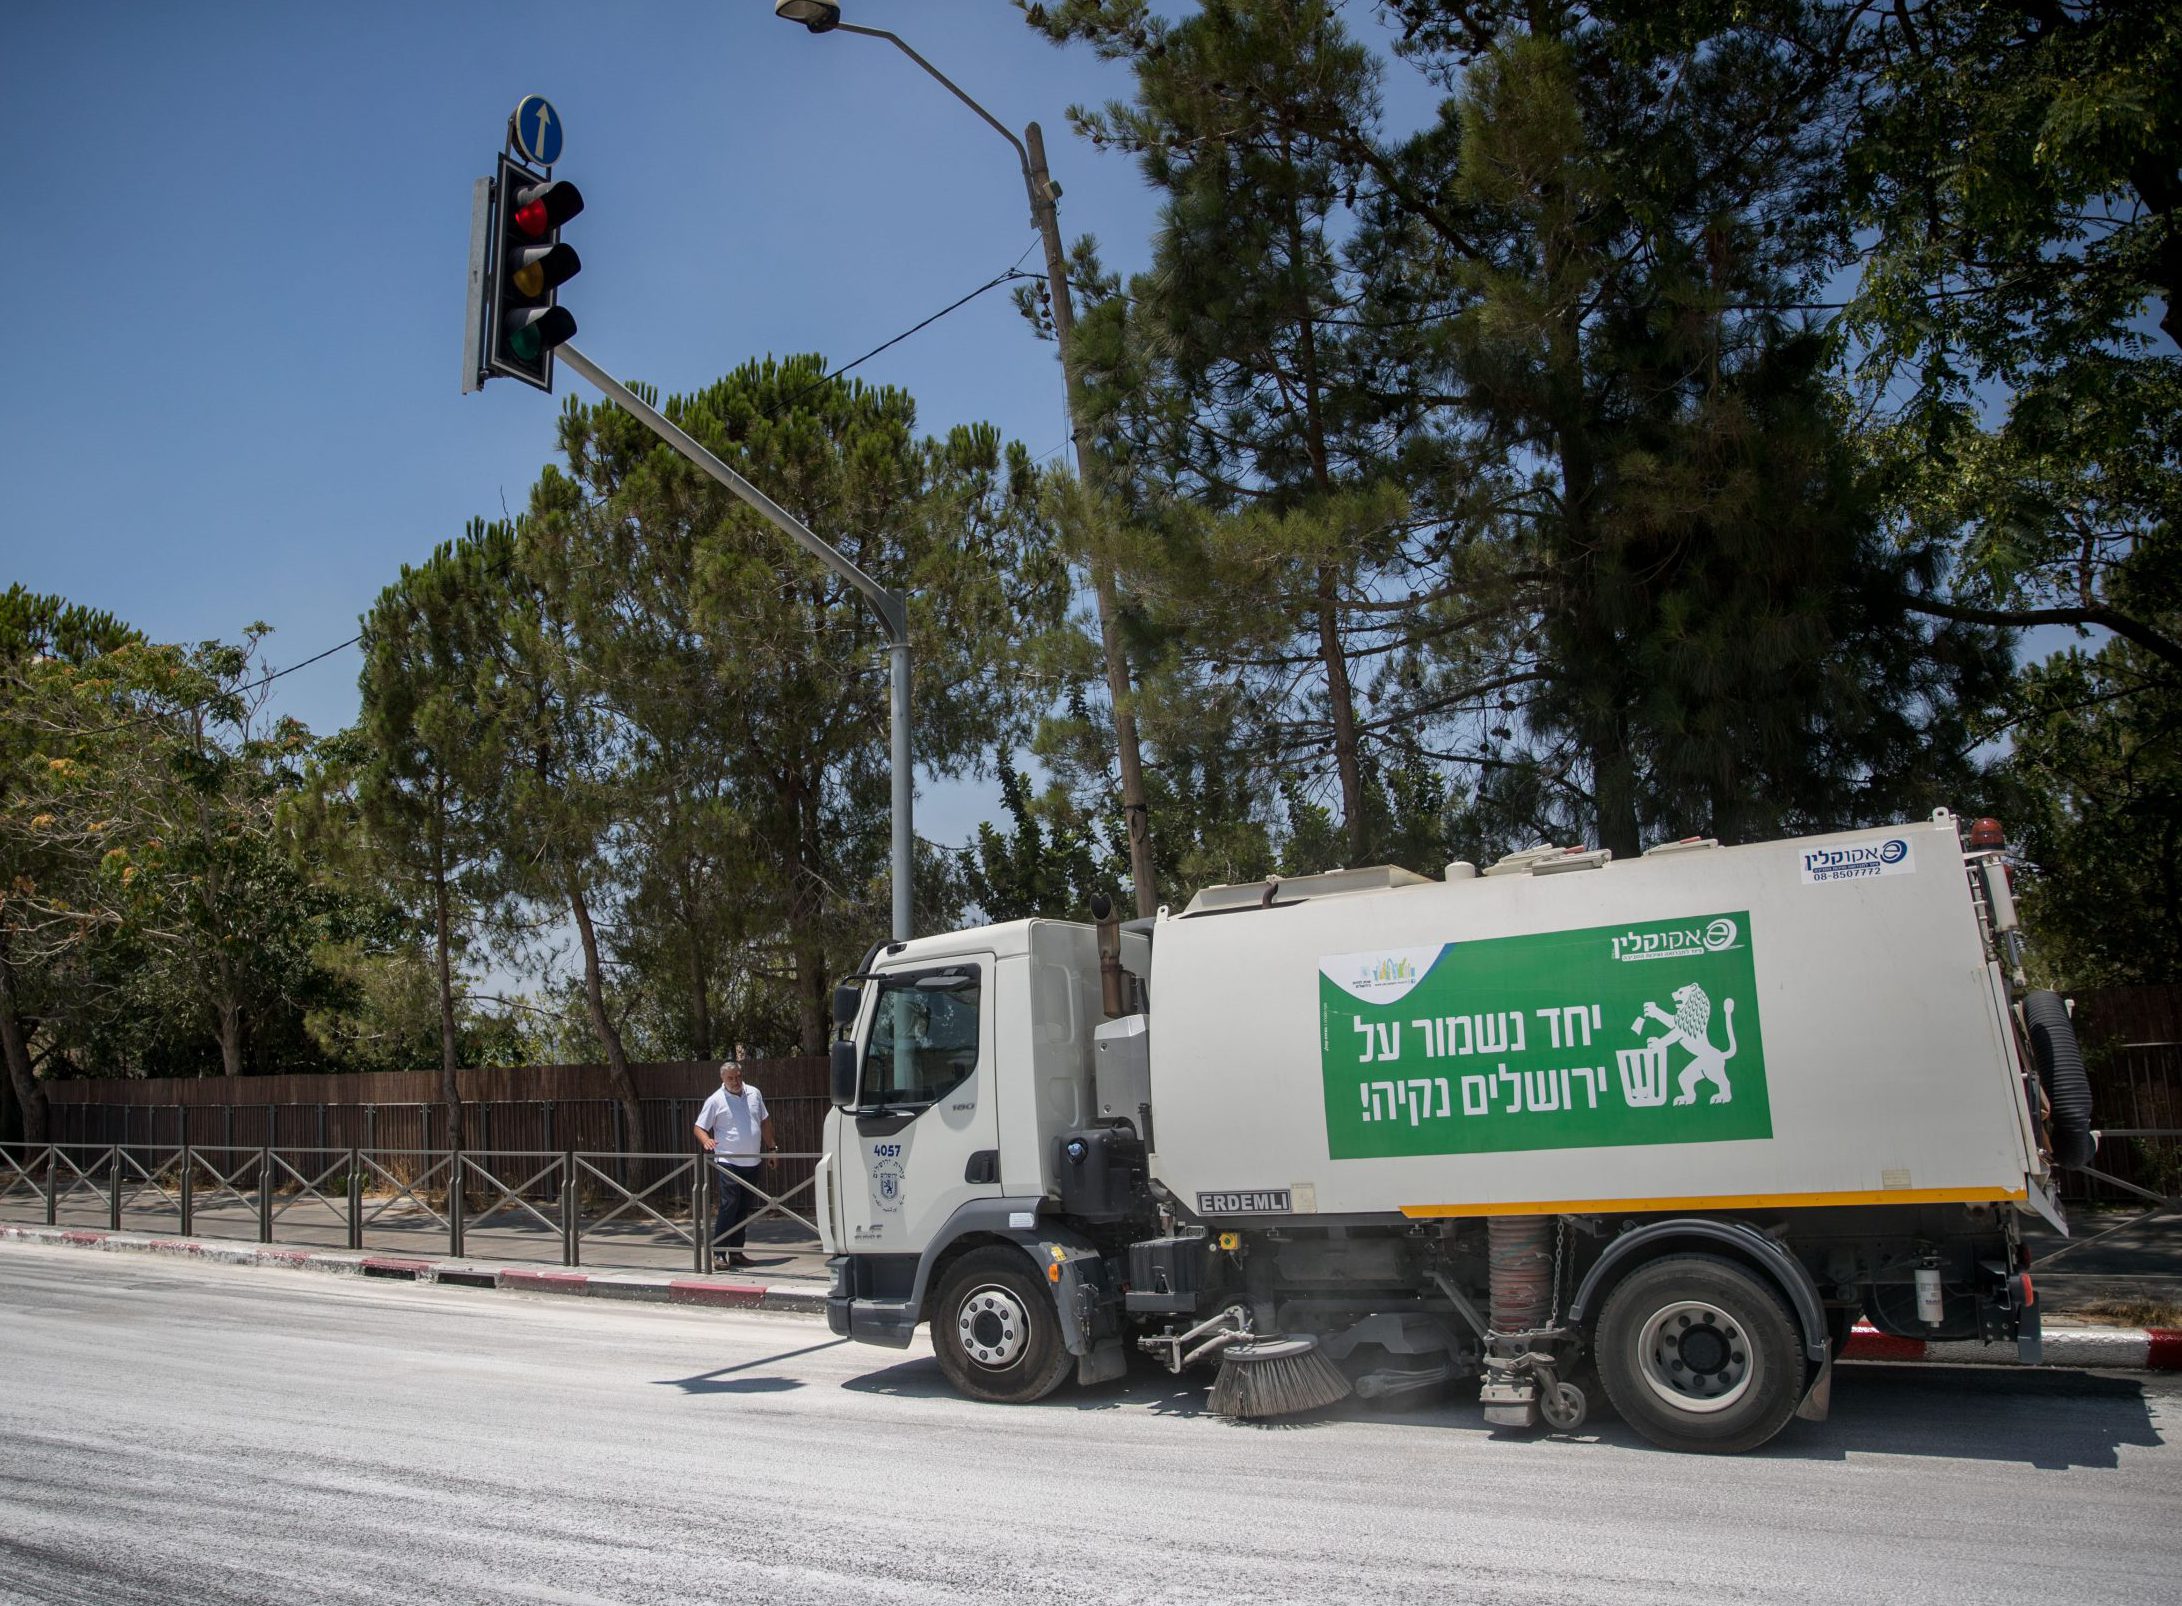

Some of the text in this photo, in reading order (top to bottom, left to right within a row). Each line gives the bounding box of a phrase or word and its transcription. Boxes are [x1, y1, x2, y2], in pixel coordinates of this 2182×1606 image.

[1805, 847, 1878, 871] אקוקלין
[1814, 867, 1881, 881] 08-8507772
[1611, 929, 1702, 959] אקוקלין
[1353, 1015, 1400, 1063] על
[1411, 1011, 1526, 1058] נשמור
[1536, 1004, 1602, 1049] יחד
[1360, 1063, 1608, 1127] ירושלים נקיה!
[874, 1144, 901, 1157] 4057
[1200, 1192, 1288, 1212] ERDEMLI
